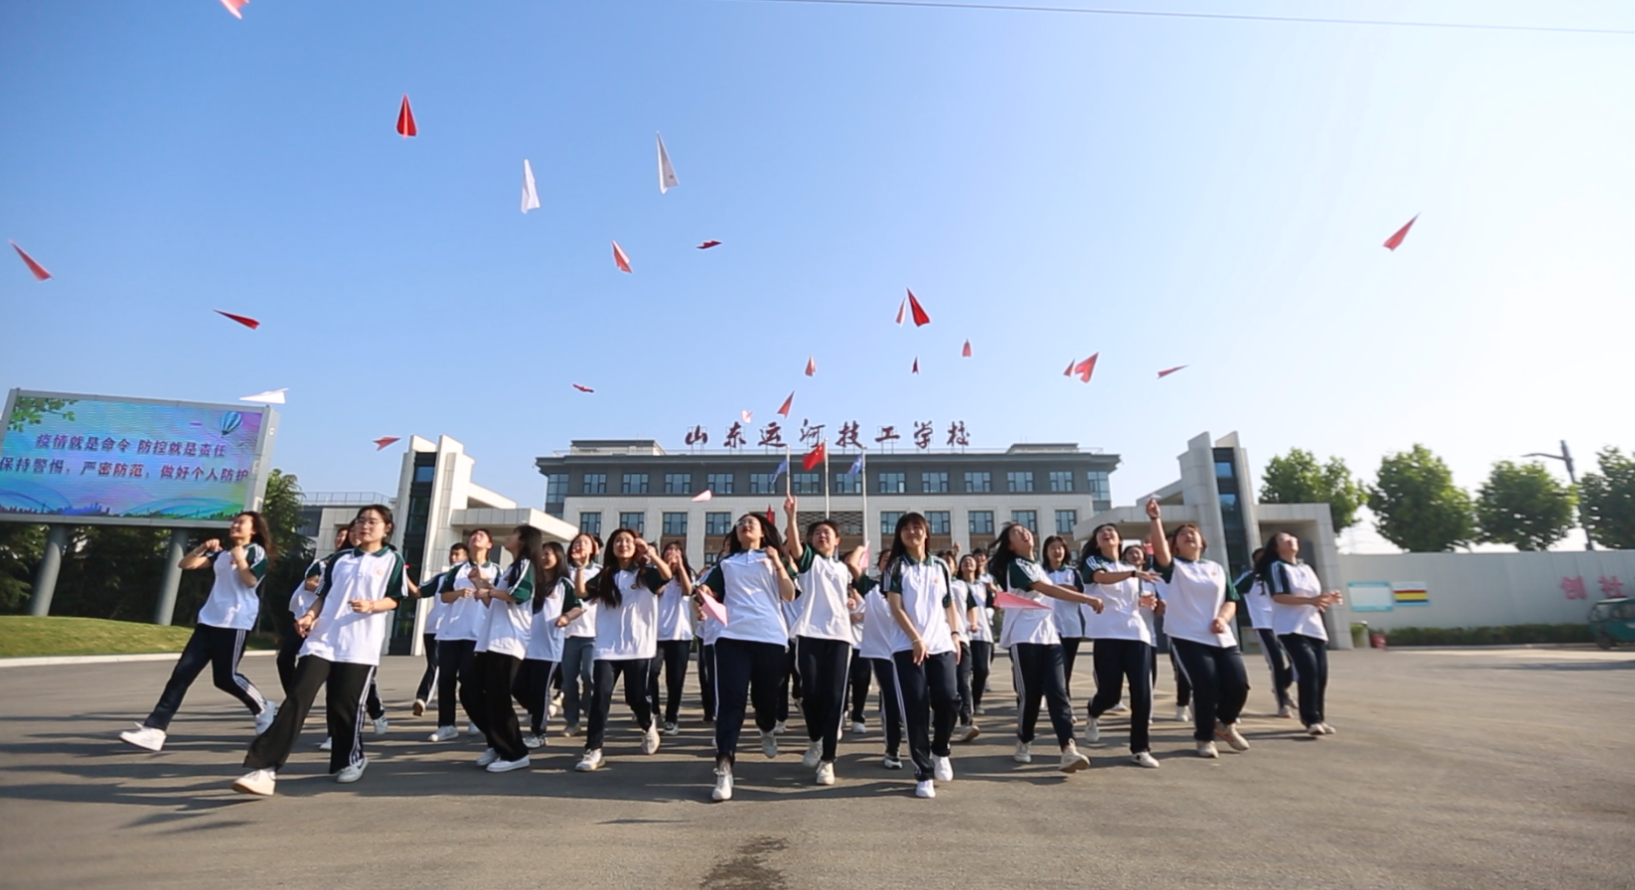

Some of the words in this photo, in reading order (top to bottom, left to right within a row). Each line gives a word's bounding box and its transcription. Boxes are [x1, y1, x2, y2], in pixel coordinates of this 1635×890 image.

[36, 433, 131, 452] 疫情就是命令
[137, 440, 227, 457] 防控就是责任
[685, 418, 971, 449] 山东运河技工学校
